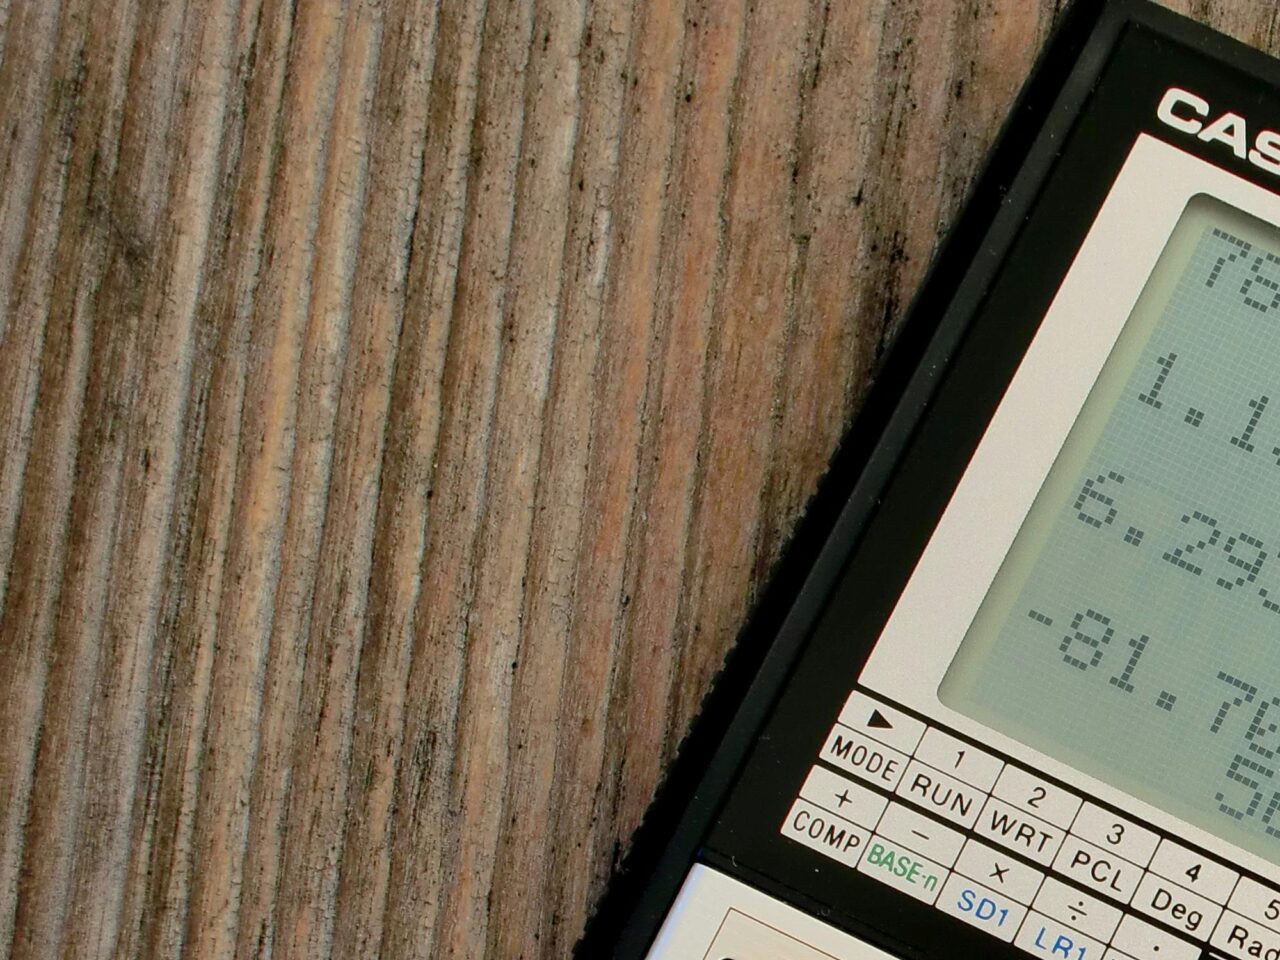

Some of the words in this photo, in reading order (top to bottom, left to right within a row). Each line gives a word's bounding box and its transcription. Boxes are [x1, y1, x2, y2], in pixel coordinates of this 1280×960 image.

[830, 735, 898, 781] MODE
[954, 750, 965, 769] 1
[910, 773, 972, 816] RUN
[1026, 786, 1046, 808] 2
[793, 810, 860, 852] COMP
[990, 810, 1052, 852] WRT
[1106, 823, 1125, 845] 3
[1070, 849, 1121, 892] PCL
[1185, 863, 1202, 882] 4
[957, 889, 1008, 926] SD1
[1150, 888, 1203, 931] Deg
